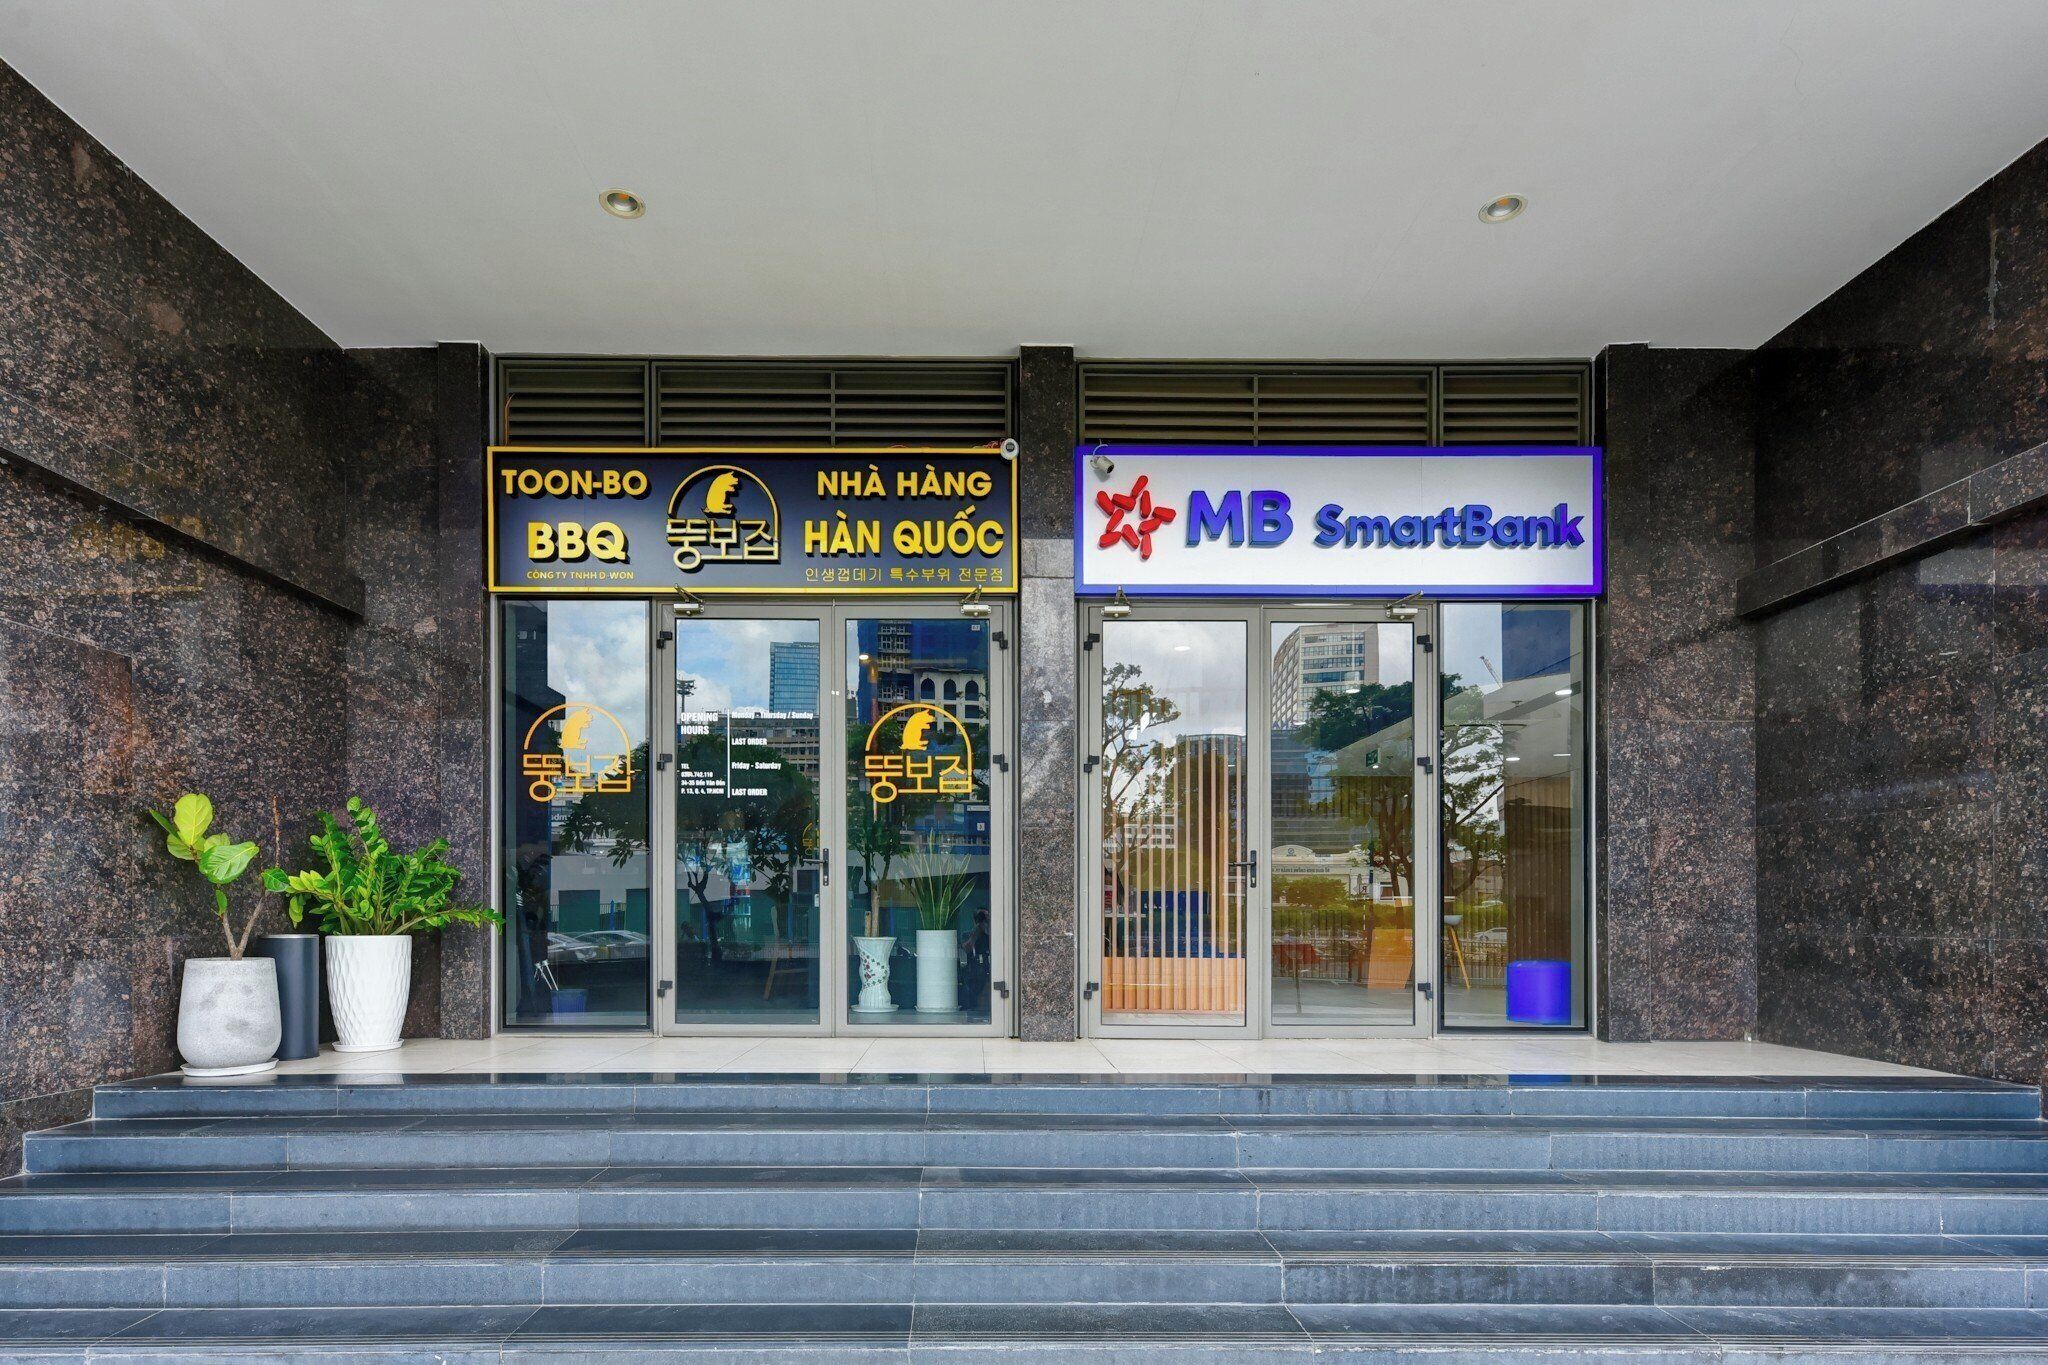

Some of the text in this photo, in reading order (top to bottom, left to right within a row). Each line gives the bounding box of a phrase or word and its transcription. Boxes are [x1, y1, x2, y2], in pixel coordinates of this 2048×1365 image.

[501, 469, 648, 496] TOON-BO
[817, 463, 992, 497] NHÀ HÀNG
[804, 504, 1005, 555] HÀN QUỐC
[1185, 489, 1586, 547] MB SmartBank
[527, 521, 626, 560] BBQ
[666, 518, 779, 570] 뚱보집
[526, 569, 554, 580] CÔNG
[555, 571, 567, 580] TY
[570, 571, 597, 580] TNHH
[805, 567, 1004, 582] 인생껍데기 특수부위 전문점
[681, 712, 718, 721] OPENING
[681, 725, 709, 734] HOURS
[523, 754, 631, 802] 뚱보집
[731, 762, 750, 770] Friday
[755, 762, 782, 770] Saturday
[865, 755, 972, 803] 뚱보집
[731, 788, 768, 796] LAST ORDER
